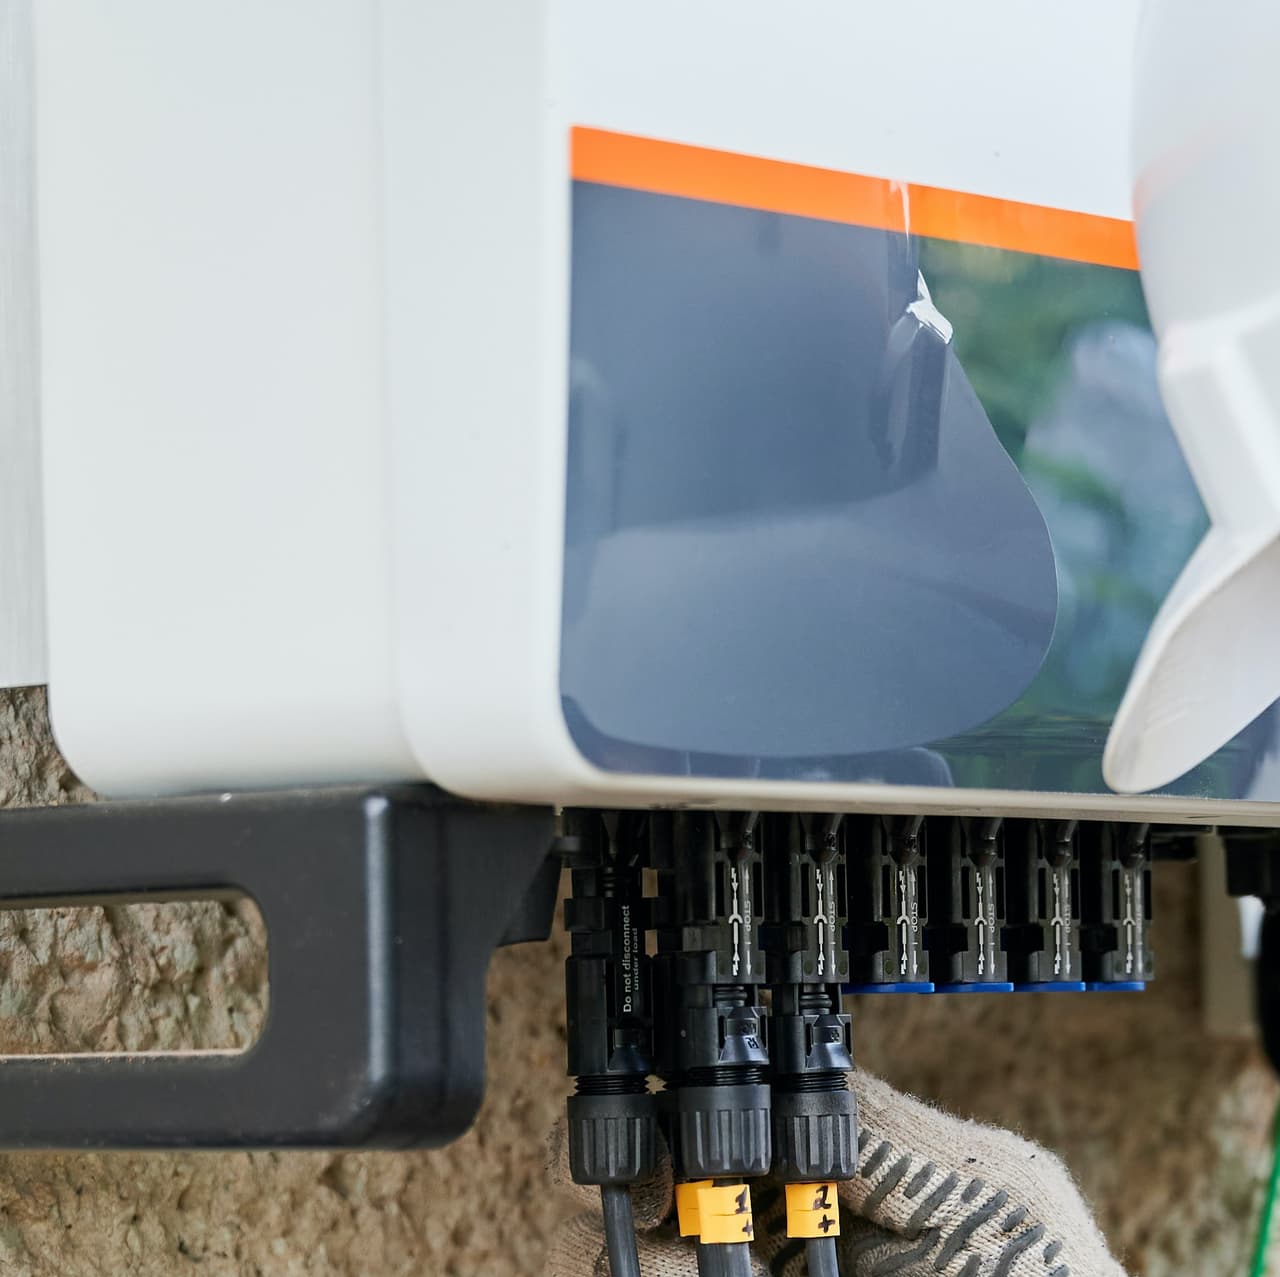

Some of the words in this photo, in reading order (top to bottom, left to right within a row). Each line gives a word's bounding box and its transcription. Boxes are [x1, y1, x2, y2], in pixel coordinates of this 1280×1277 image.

[743, 900, 751, 932] STOP
[828, 901, 836, 932] STOP
[910, 902, 918, 932] STOP
[987, 903, 995, 933] STOP
[621, 904, 631, 970] disconnect
[623, 973, 632, 993] not
[623, 995, 632, 1013] Do
